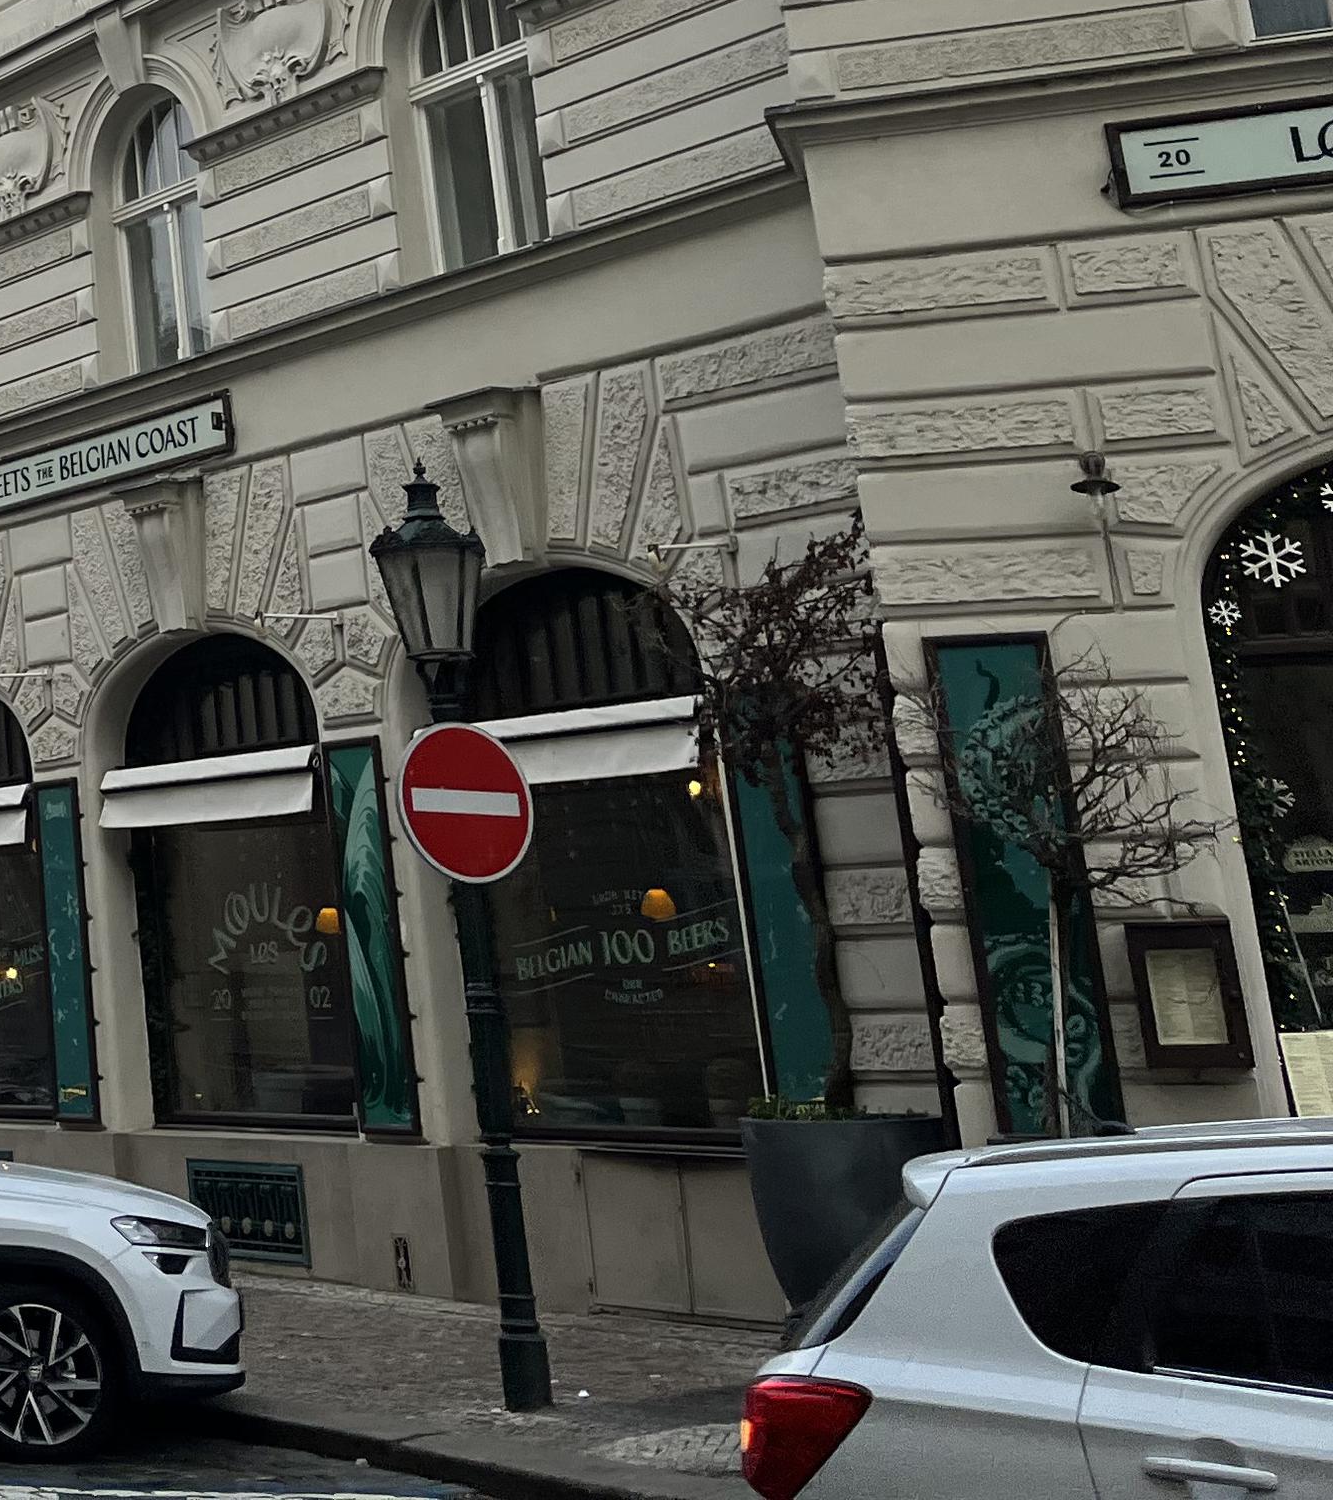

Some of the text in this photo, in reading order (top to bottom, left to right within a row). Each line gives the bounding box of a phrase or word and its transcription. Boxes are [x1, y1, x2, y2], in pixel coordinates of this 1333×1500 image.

[1158, 149, 1191, 168] 20
[36, 465, 54, 481] THE
[59, 436, 131, 481] BELGIAN
[135, 416, 199, 459] COAST
[516, 916, 730, 981] BELGIAN 100 BEERS
[309, 985, 332, 1009] 02
